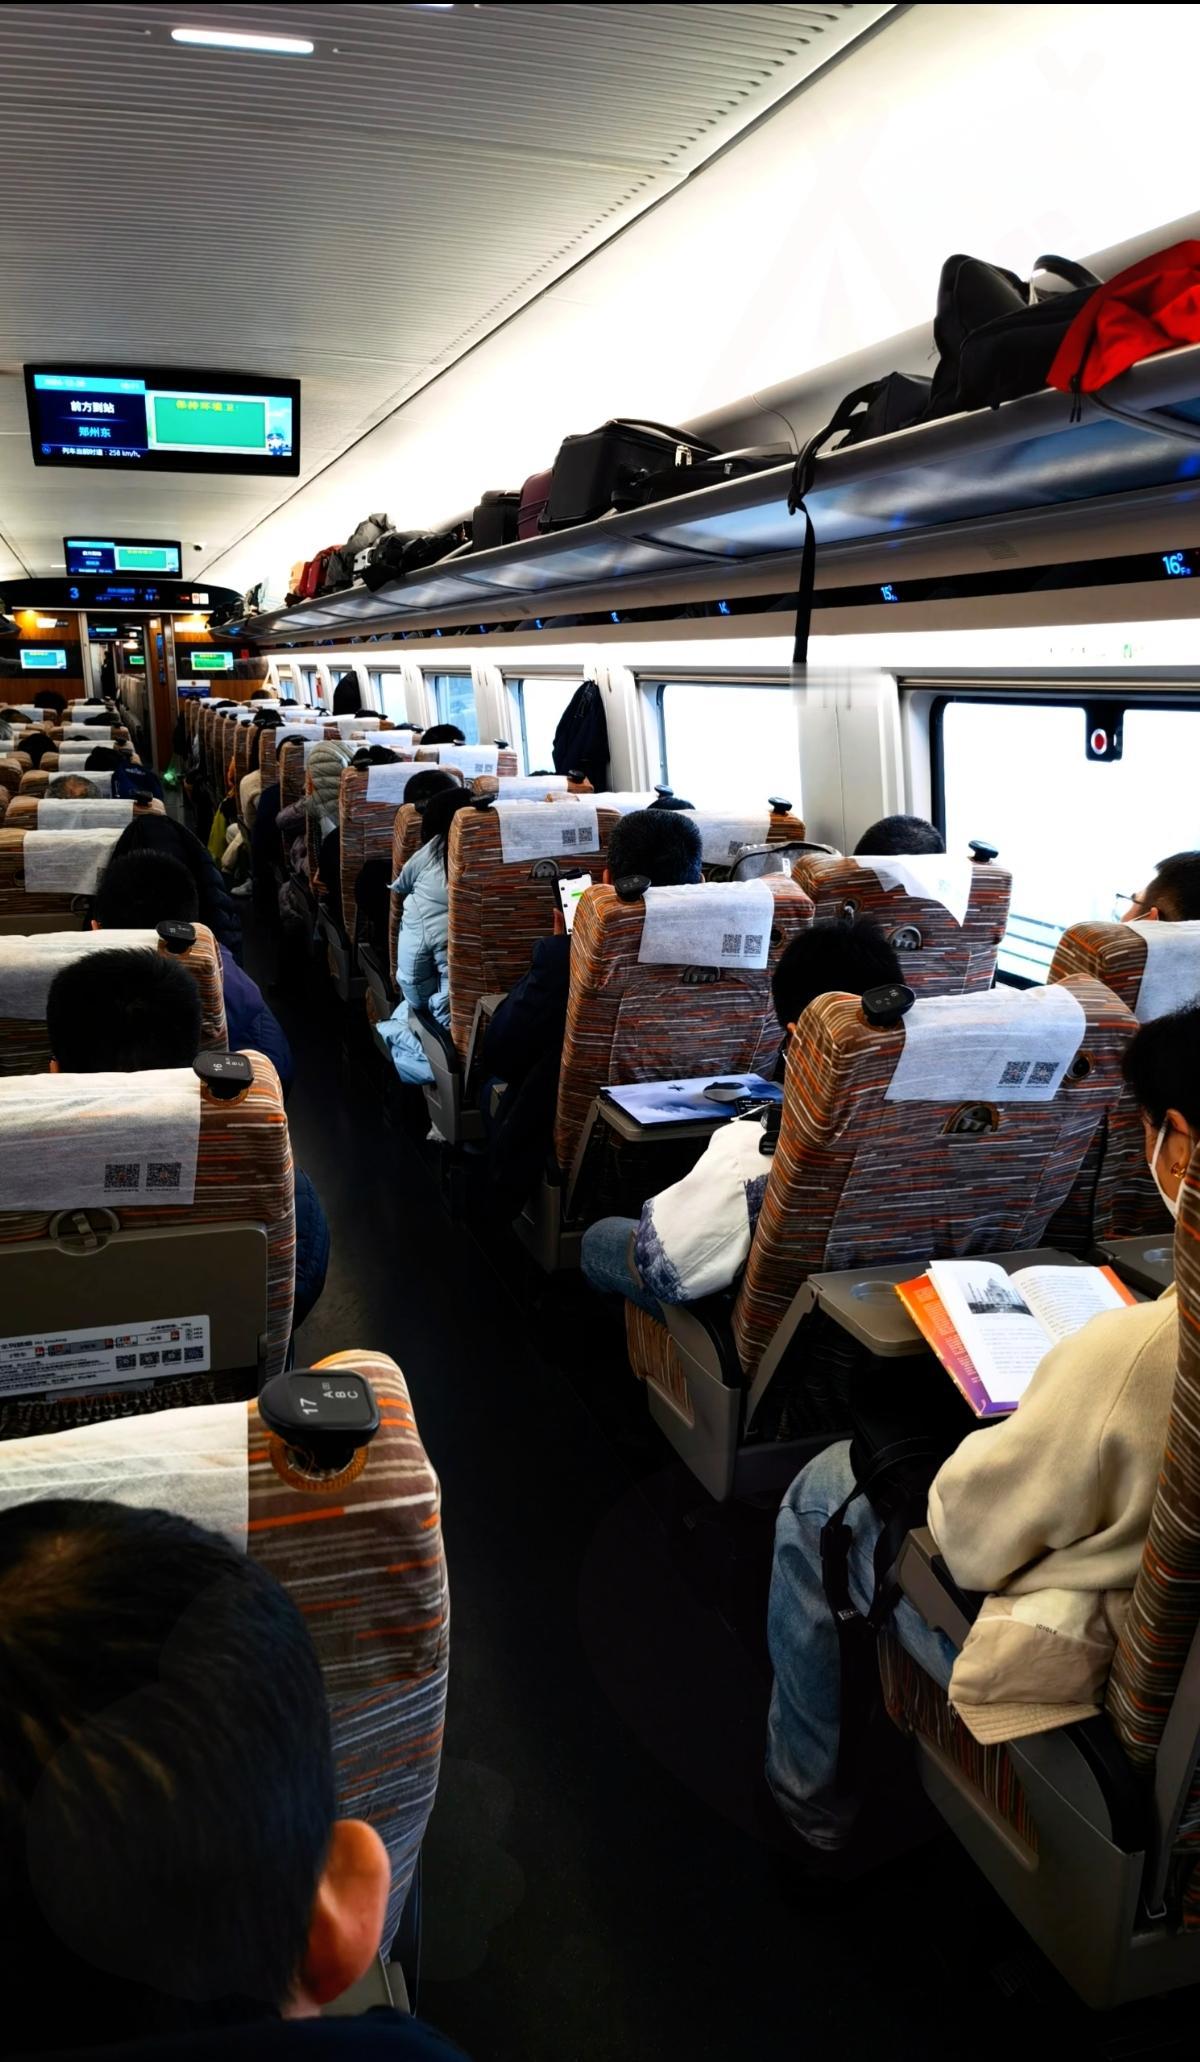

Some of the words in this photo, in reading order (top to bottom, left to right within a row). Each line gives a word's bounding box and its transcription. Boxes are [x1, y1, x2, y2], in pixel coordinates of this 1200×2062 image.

[70, 400, 115, 414] 前方到站
[78, 426, 112, 438] 郑州东
[69, 586, 80, 600] 3
[299, 1397, 319, 1416] 17
